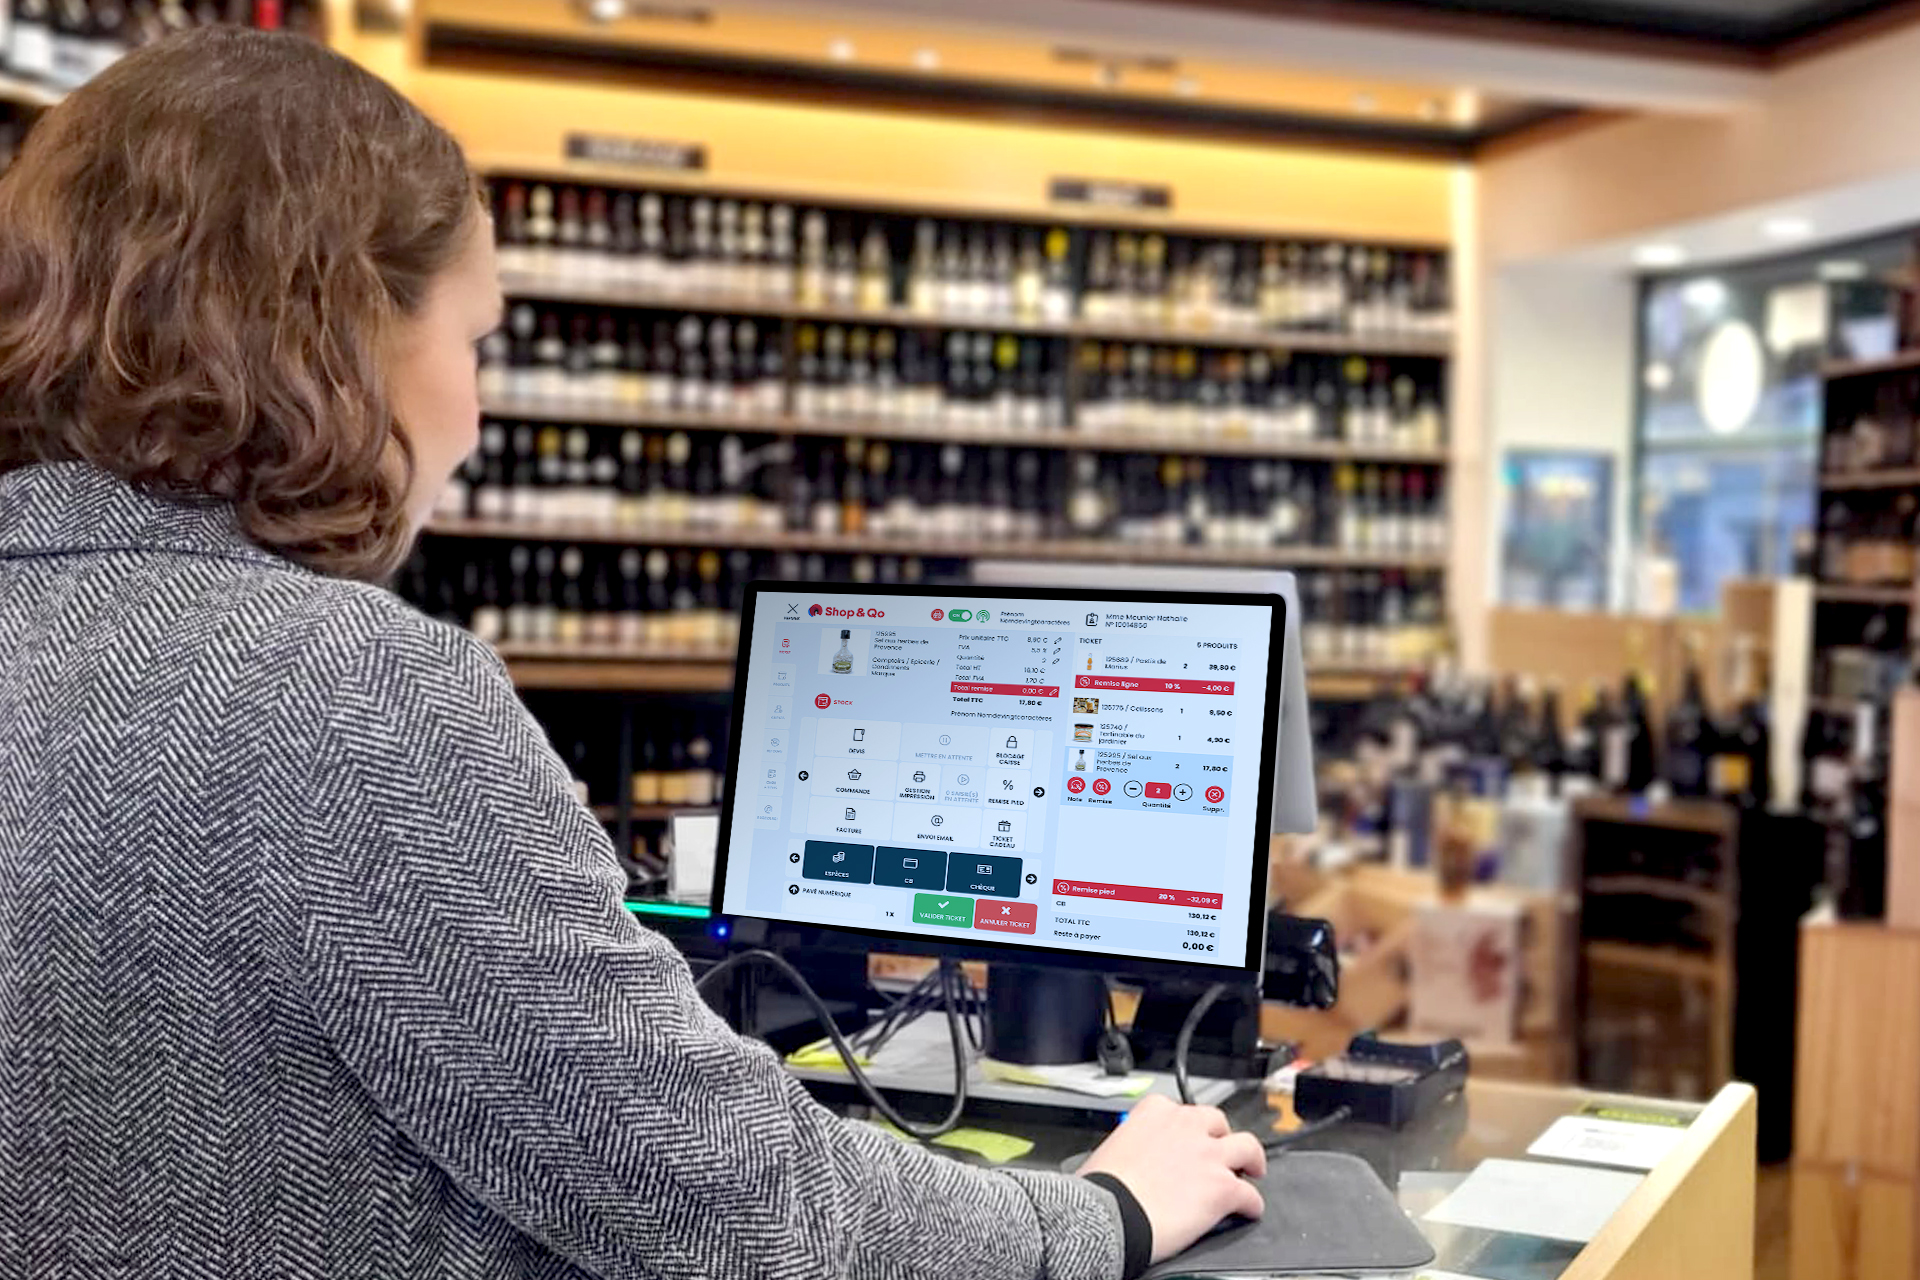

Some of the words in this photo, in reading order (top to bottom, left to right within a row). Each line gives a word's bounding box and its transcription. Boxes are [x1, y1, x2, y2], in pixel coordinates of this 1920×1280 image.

[825, 607, 854, 619] Shop
[856, 608, 865, 617] &
[867, 608, 885, 618] Qo
[1094, 680, 1120, 688] Remise
[970, 884, 996, 892] CHÈQUE
[1182, 941, 1204, 950] 0,00
